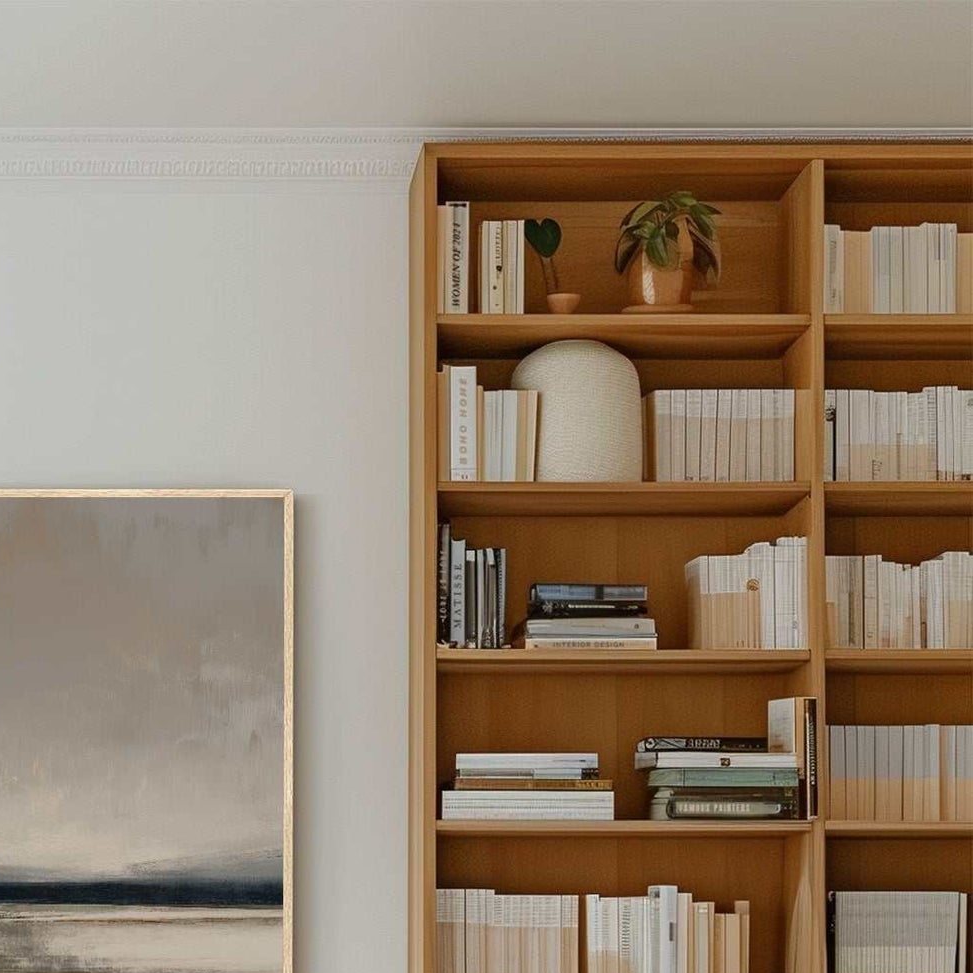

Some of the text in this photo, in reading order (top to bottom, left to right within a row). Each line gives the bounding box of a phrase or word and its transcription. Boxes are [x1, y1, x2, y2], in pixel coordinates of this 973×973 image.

[451, 246, 461, 262] OF
[451, 264, 461, 307] WOMEN
[458, 376, 468, 418] HOME
[458, 424, 468, 466] BOHO
[453, 562, 462, 629] MATISSE
